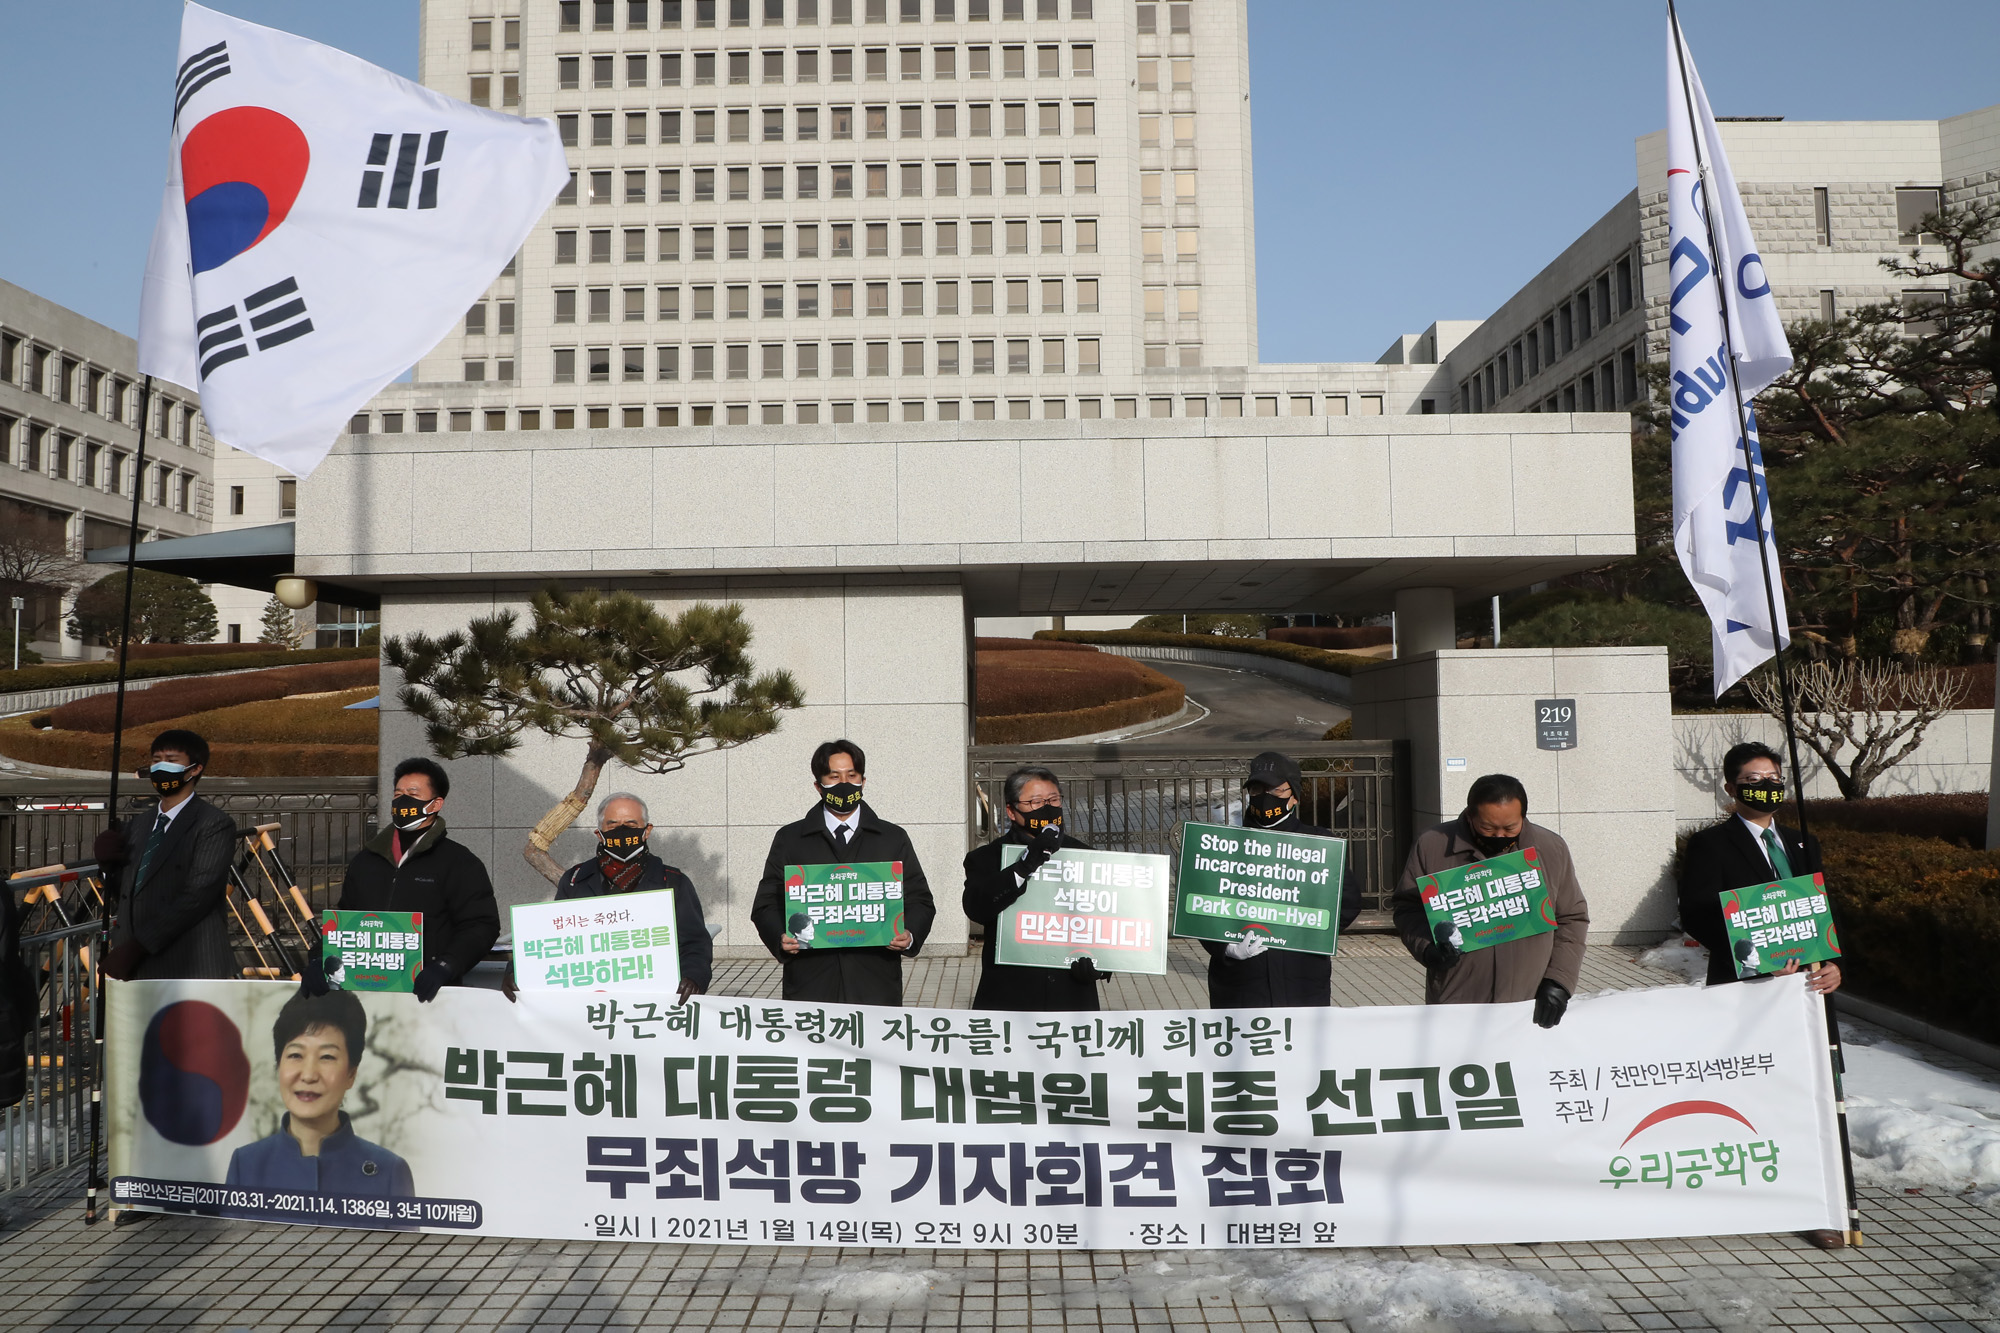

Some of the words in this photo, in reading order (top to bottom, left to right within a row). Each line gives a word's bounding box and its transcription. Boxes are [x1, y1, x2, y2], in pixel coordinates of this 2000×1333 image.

[1540, 706, 1572, 723] 219
[826, 793, 844, 808] 탄핵
[846, 790, 862, 805] 무효
[1742, 789, 1767, 803] 탄핵
[400, 807, 418, 818] 무효
[1265, 806, 1282, 819] 무효
[606, 838, 621, 848] 탄핵
[625, 836, 639, 847] 무효
[1200, 834, 1239, 855] Stop
[1244, 838, 1271, 857] the
[1276, 843, 1327, 864] illegal
[829, 872, 858, 881] 우리공화당
[1090, 862, 1154, 888] 대통령
[1194, 854, 1306, 883] incarceration
[1310, 869, 1330, 885] of
[1464, 868, 1493, 882] 우리공화당
[788, 883, 843, 904] 박근혜
[848, 881, 903, 901] 대통령
[1053, 887, 1118, 914] 석방이
[1219, 878, 1300, 903] President
[1428, 884, 1485, 912] 박근혜
[1485, 869, 1541, 898] 대통령
[1761, 889, 1787, 901] 우리공화당
[359, 920, 384, 928] 우리공화당
[552, 914, 590, 931] 법치는
[593, 909, 635, 926] 죽었다.
[807, 903, 885, 925] 무죄석방!
[1192, 896, 1231, 916] Park
[1235, 901, 1323, 927] Geun-Hye!
[1451, 894, 1531, 929] 즉각석방!
[1730, 904, 1779, 930] 박근혜
[1780, 894, 1828, 920] 대통령
[327, 930, 371, 949] 박근혜
[375, 932, 420, 950] 대통령
[523, 935, 584, 960] 박근혜
[590, 925, 671, 953] 대통령을
[1020, 914, 1151, 947] 민심입니다!
[1224, 930, 1237, 939] Our
[1270, 936, 1287, 946] Party
[1750, 919, 1818, 949] 즉각석방!
[341, 951, 405, 971] 즉각석방!
[544, 954, 654, 988] 석방하라!
[586, 998, 701, 1040] 박근혜
[718, 1008, 866, 1049] 대통령께
[881, 1013, 1013, 1056] 자유를!
[1027, 1018, 1145, 1059] 국민께
[1162, 1015, 1294, 1058] 희망을!
[1547, 1069, 1588, 1094] 주최
[1609, 1052, 1776, 1089] 천만인무죄석방본부
[443, 1046, 639, 1119] 박근혜
[663, 1054, 873, 1123] 대통령
[899, 1065, 1111, 1127] 대법원
[1136, 1070, 1280, 1136] 최종
[1305, 1061, 1525, 1137] 선고일
[1555, 1102, 1594, 1125] 주관
[585, 1135, 867, 1204] 무죄석방
[888, 1141, 1178, 1207] 기자회견
[1200, 1144, 1345, 1207] 집회
[1600, 1139, 1781, 1190] 우리공화당
[340, 1197, 394, 1220] 1386일,
[396, 1201, 422, 1220] 3년
[425, 1202, 478, 1224] 10개월)
[667, 1216, 748, 1241] 2021년
[759, 1218, 796, 1243] 1월
[806, 1219, 903, 1245] 14일(목)
[913, 1221, 963, 1245] 오전
[973, 1222, 1013, 1245] 9시
[1024, 1222, 1079, 1246] 30분
[1226, 1221, 1302, 1245] 대법원
[1313, 1220, 1338, 1244] 앞
